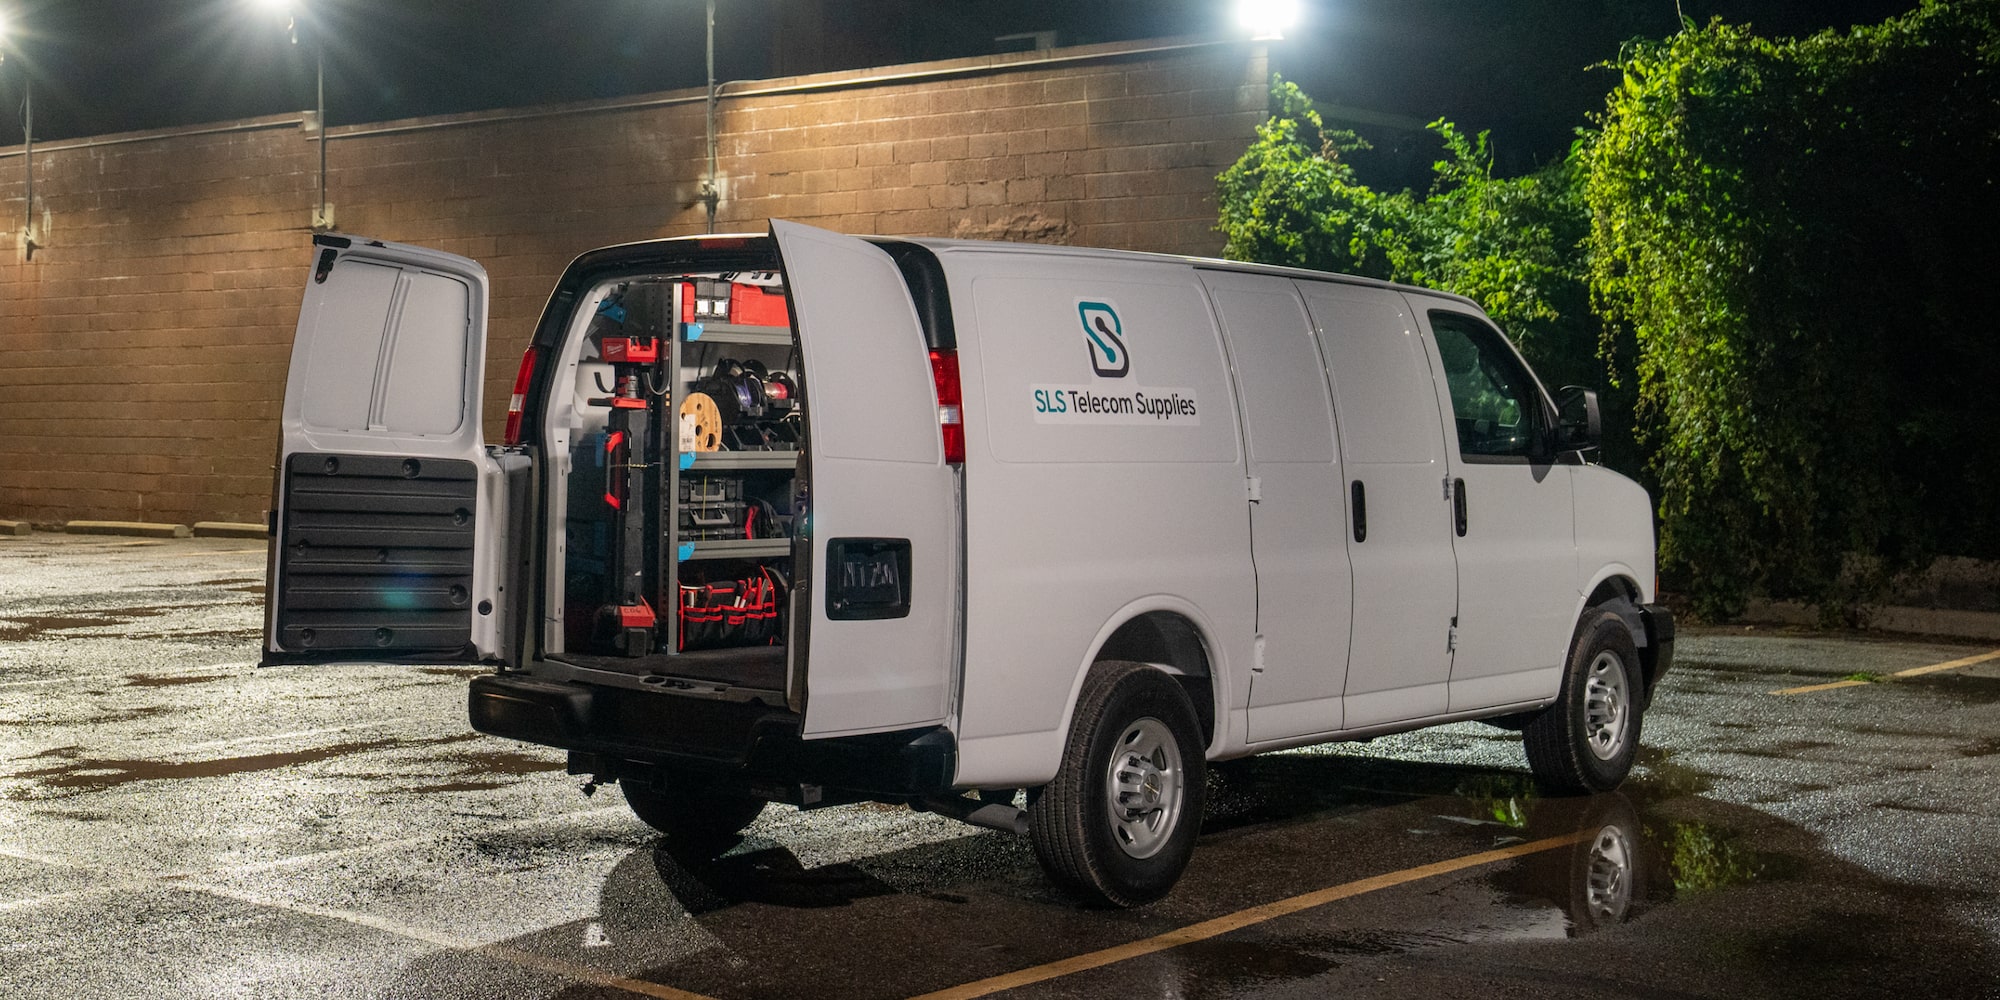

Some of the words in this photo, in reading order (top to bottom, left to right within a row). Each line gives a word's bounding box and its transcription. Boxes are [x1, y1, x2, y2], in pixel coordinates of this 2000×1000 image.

[1034, 389, 1067, 413] SLS
[1068, 390, 1134, 414] Telecom
[1135, 392, 1196, 420] Supplies
